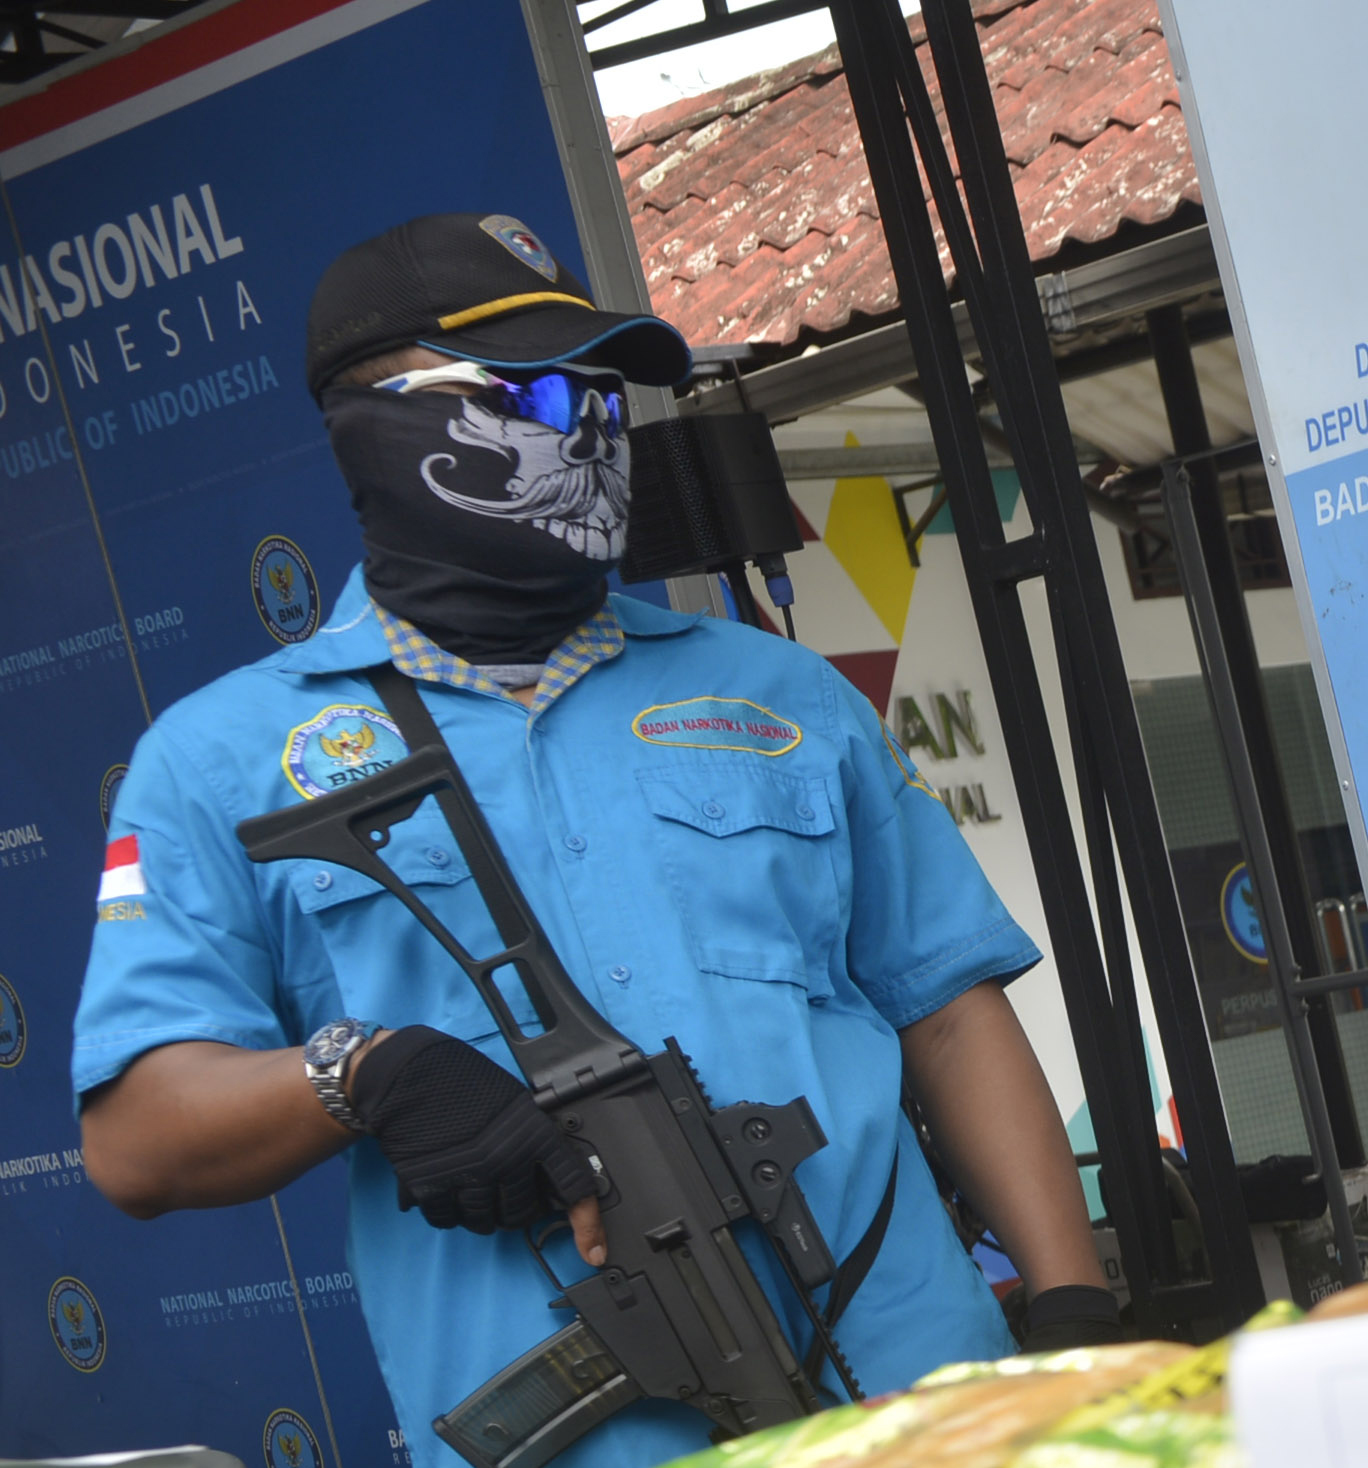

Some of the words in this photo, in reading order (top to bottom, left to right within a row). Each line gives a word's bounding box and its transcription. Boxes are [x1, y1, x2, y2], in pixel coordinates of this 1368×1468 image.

[0, 280, 262, 418] ONESIA
[0, 425, 73, 479] UBLIC
[84, 411, 119, 450] OF
[131, 355, 279, 435] INDONESIA
[134, 607, 184, 636] BOARD
[278, 603, 304, 623] BNN
[640, 719, 680, 737] BADAN
[682, 717, 744, 734] NARKOTIKA
[745, 723, 800, 740] NASIONAL
[160, 1290, 223, 1314] NATIONAL
[305, 1271, 353, 1295] BOARD
